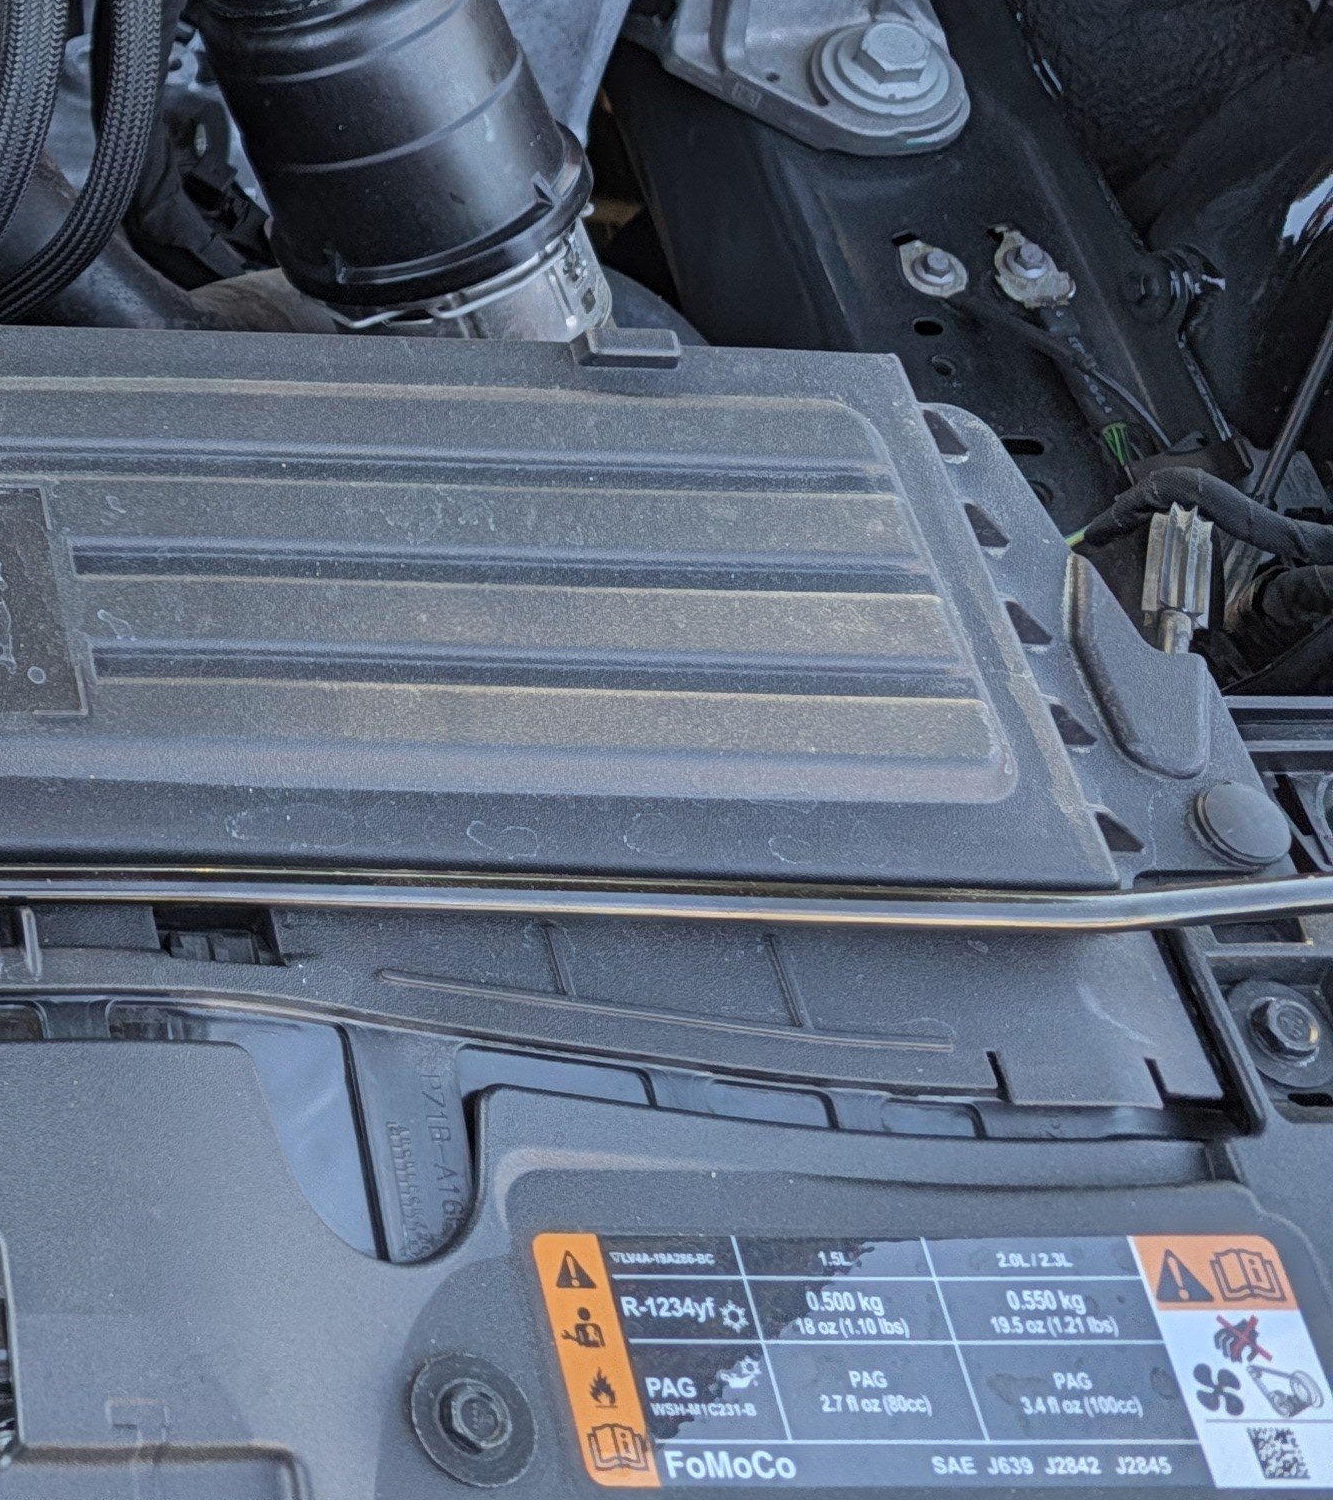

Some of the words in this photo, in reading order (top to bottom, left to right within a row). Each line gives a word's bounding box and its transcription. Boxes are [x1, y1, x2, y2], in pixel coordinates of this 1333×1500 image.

[817, 1250, 852, 1267] 1.5L
[997, 1252, 1029, 1268] 2.0L
[1039, 1252, 1073, 1268] 2.3L
[620, 1296, 717, 1323] R-1234yf
[806, 1291, 856, 1312] 0.500
[858, 1291, 886, 1316] kg
[1006, 1290, 1057, 1312] 0.550
[1060, 1290, 1087, 1315] kg
[795, 1317, 814, 1336] 18
[818, 1321, 838, 1336] oz
[839, 1316, 878, 1339] (1.10
[880, 1316, 911, 1338] lbs)
[990, 1315, 1024, 1335] 19.5
[1025, 1320, 1047, 1335] oz
[1046, 1315, 1085, 1338] (1.21
[1086, 1315, 1119, 1337] lbs)
[645, 1377, 697, 1398] PAG
[848, 1370, 888, 1389] PAG
[1052, 1372, 1093, 1390] PAG
[819, 1394, 843, 1413] 2.7
[846, 1394, 860, 1412] fl
[861, 1398, 883, 1412] oz
[883, 1394, 932, 1417] (80cc)
[1020, 1396, 1044, 1415] 3.4
[1046, 1396, 1061, 1414] fl
[1062, 1400, 1083, 1414] oz
[1083, 1396, 1143, 1418] (100cc)
[663, 1450, 797, 1479] FoMoCo
[931, 1456, 978, 1475] SAE
[986, 1456, 1034, 1475] J639
[1044, 1456, 1103, 1475] J2842
[1114, 1456, 1173, 1475] J2845
